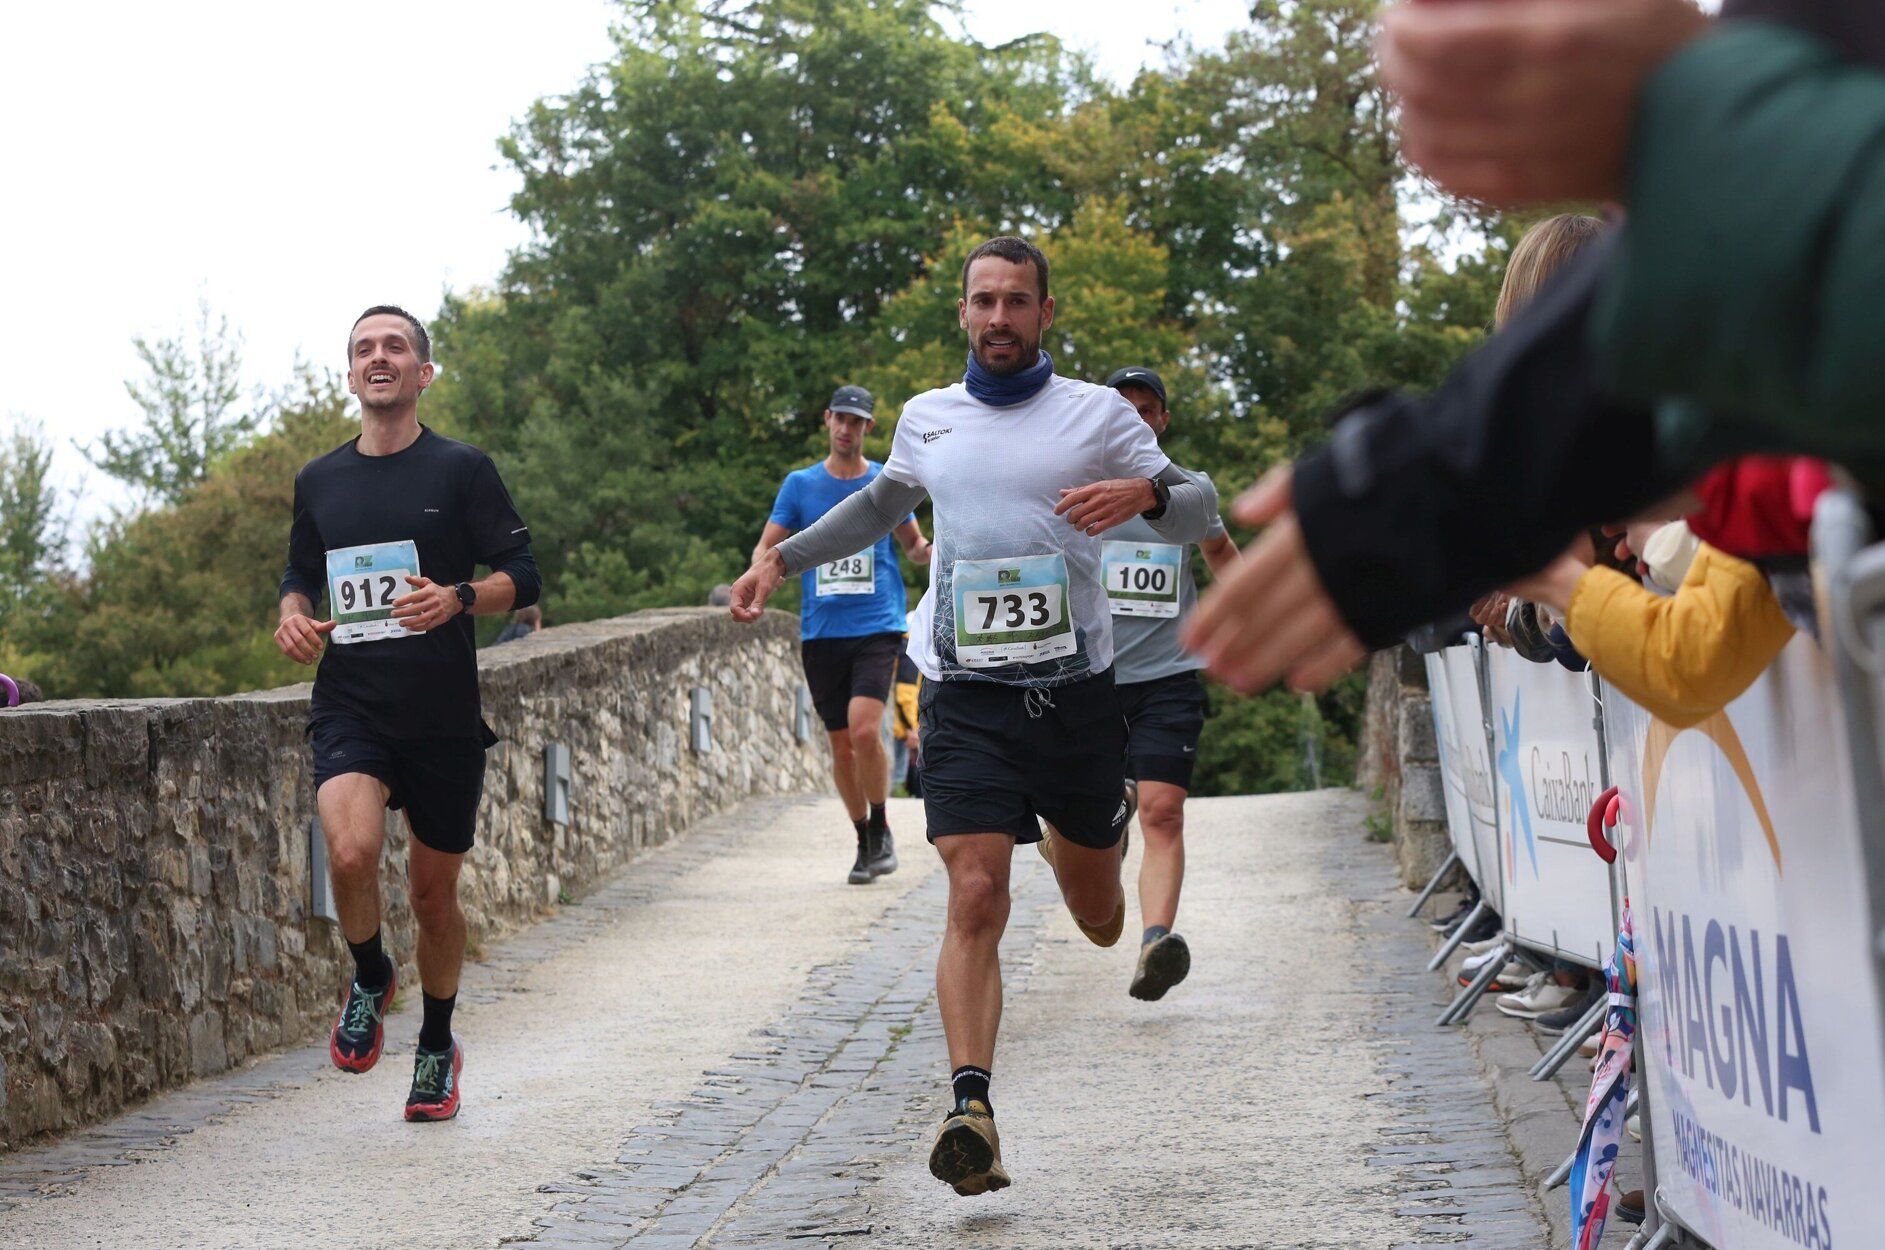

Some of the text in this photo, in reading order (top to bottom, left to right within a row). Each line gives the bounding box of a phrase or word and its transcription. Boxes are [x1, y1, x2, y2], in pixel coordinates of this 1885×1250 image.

[829, 558, 862, 577] 248
[1119, 566, 1167, 592] 100
[340, 575, 397, 611] 912
[977, 591, 1050, 630] 733
[1531, 745, 1594, 826] CaixaBank
[1653, 905, 1822, 1135] MAGNA
[1672, 1107, 1832, 1250] MAGNESITAS NAVARRAS
